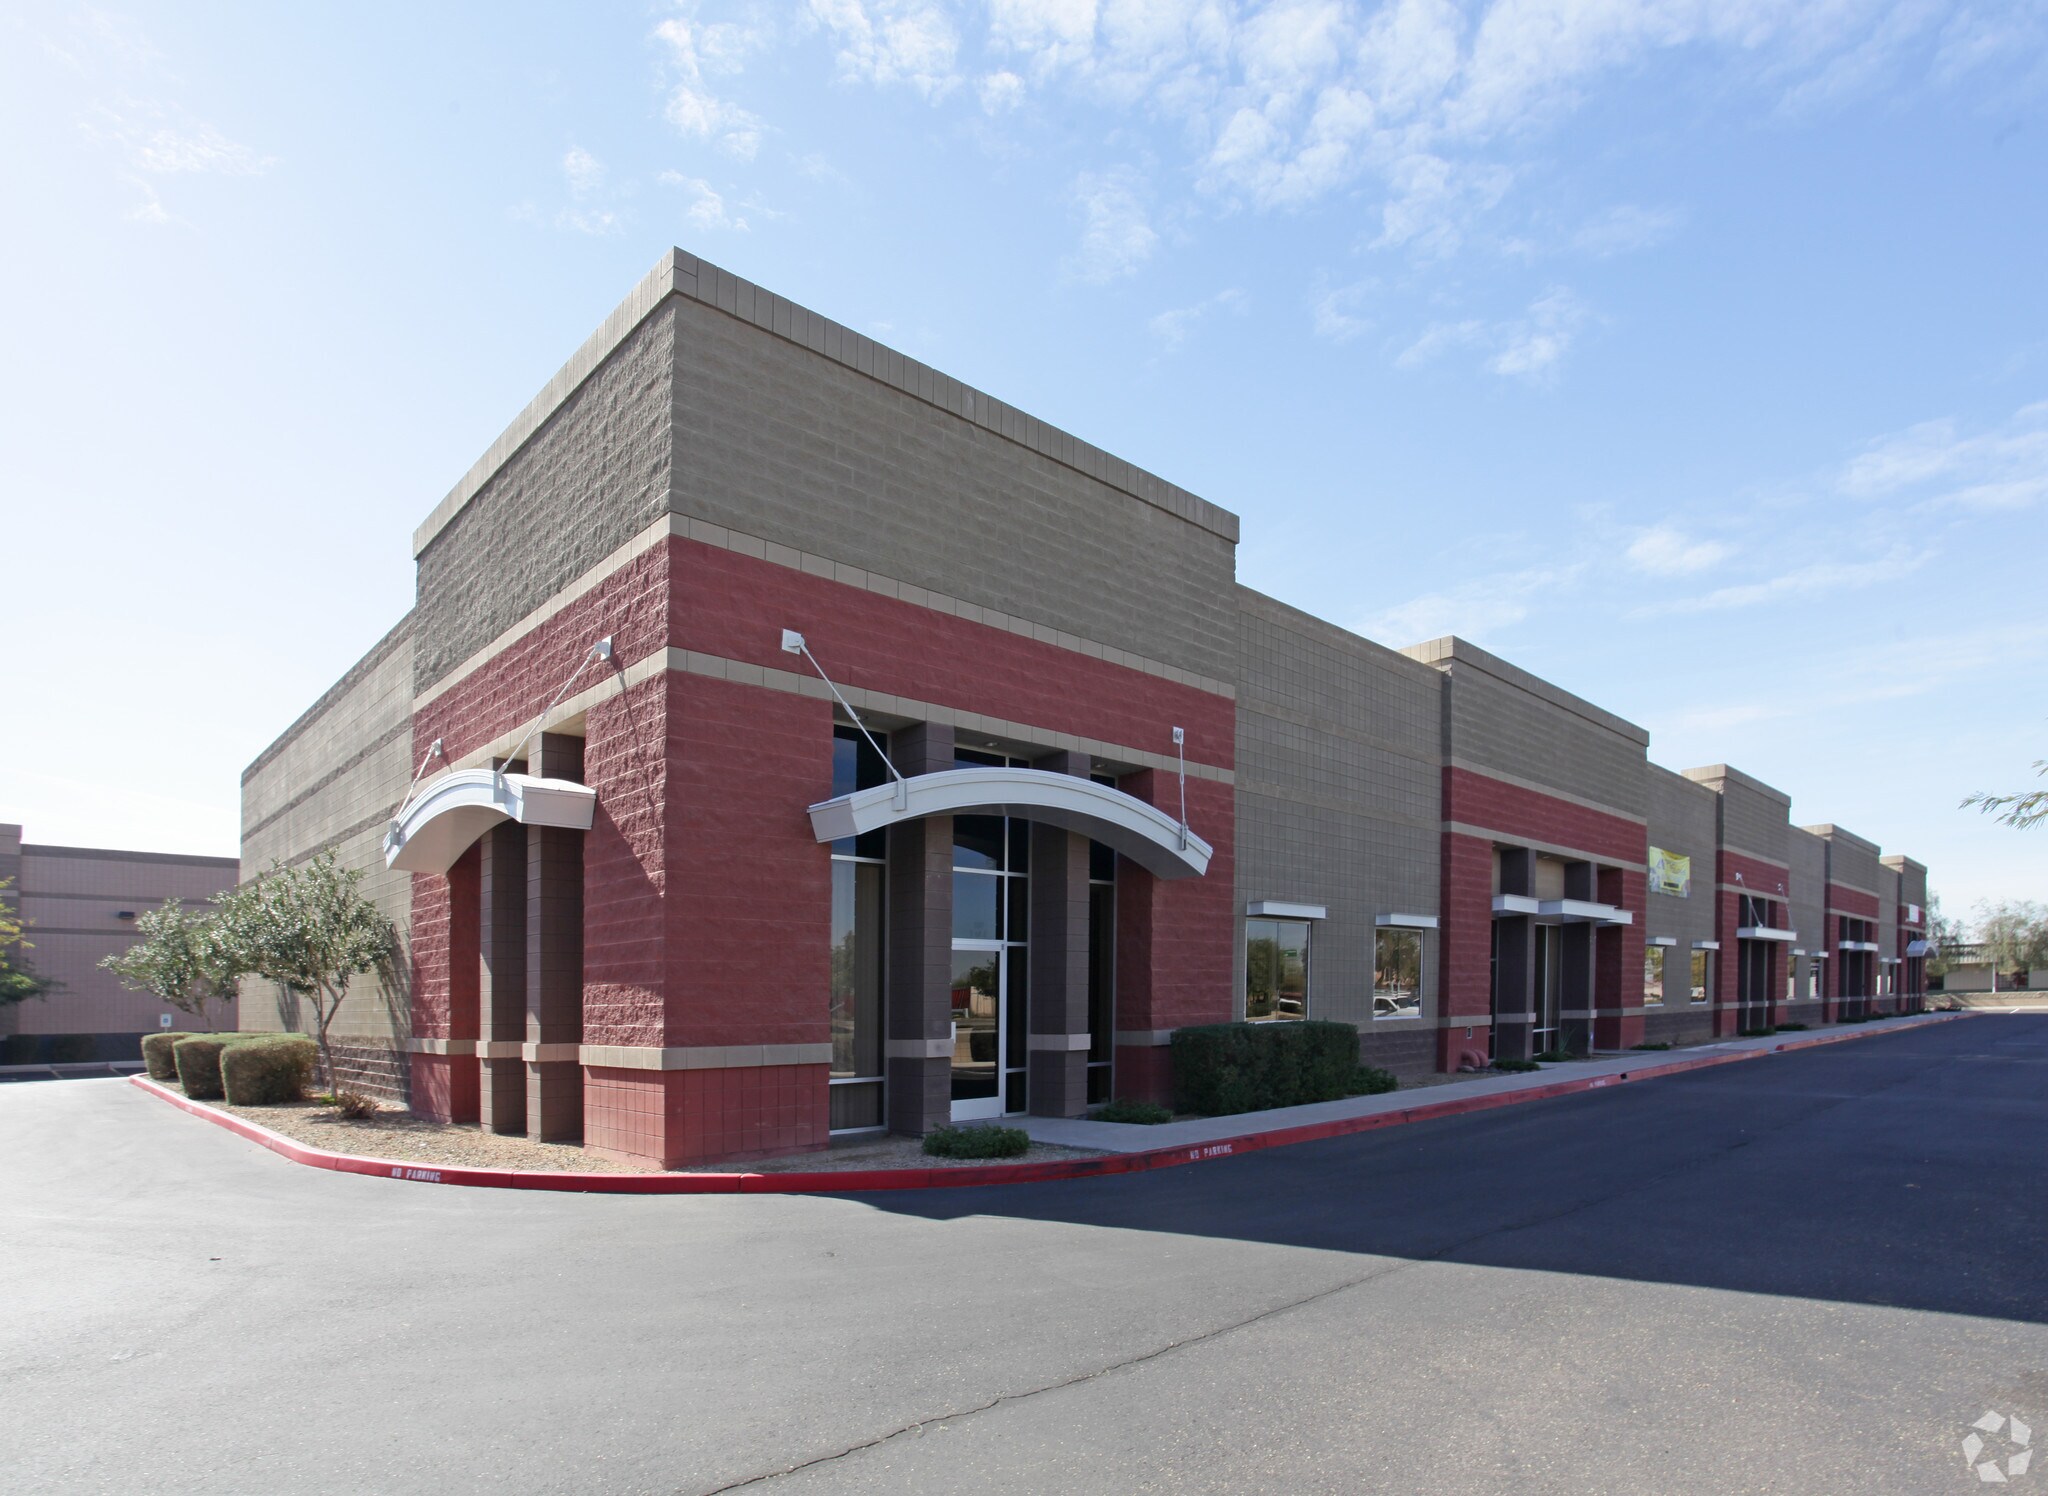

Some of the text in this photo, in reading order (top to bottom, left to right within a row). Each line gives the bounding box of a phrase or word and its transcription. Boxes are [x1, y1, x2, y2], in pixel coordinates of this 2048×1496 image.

[1203, 1144, 1233, 1158] PARKING
[391, 1167, 441, 1182] NO PARKING
